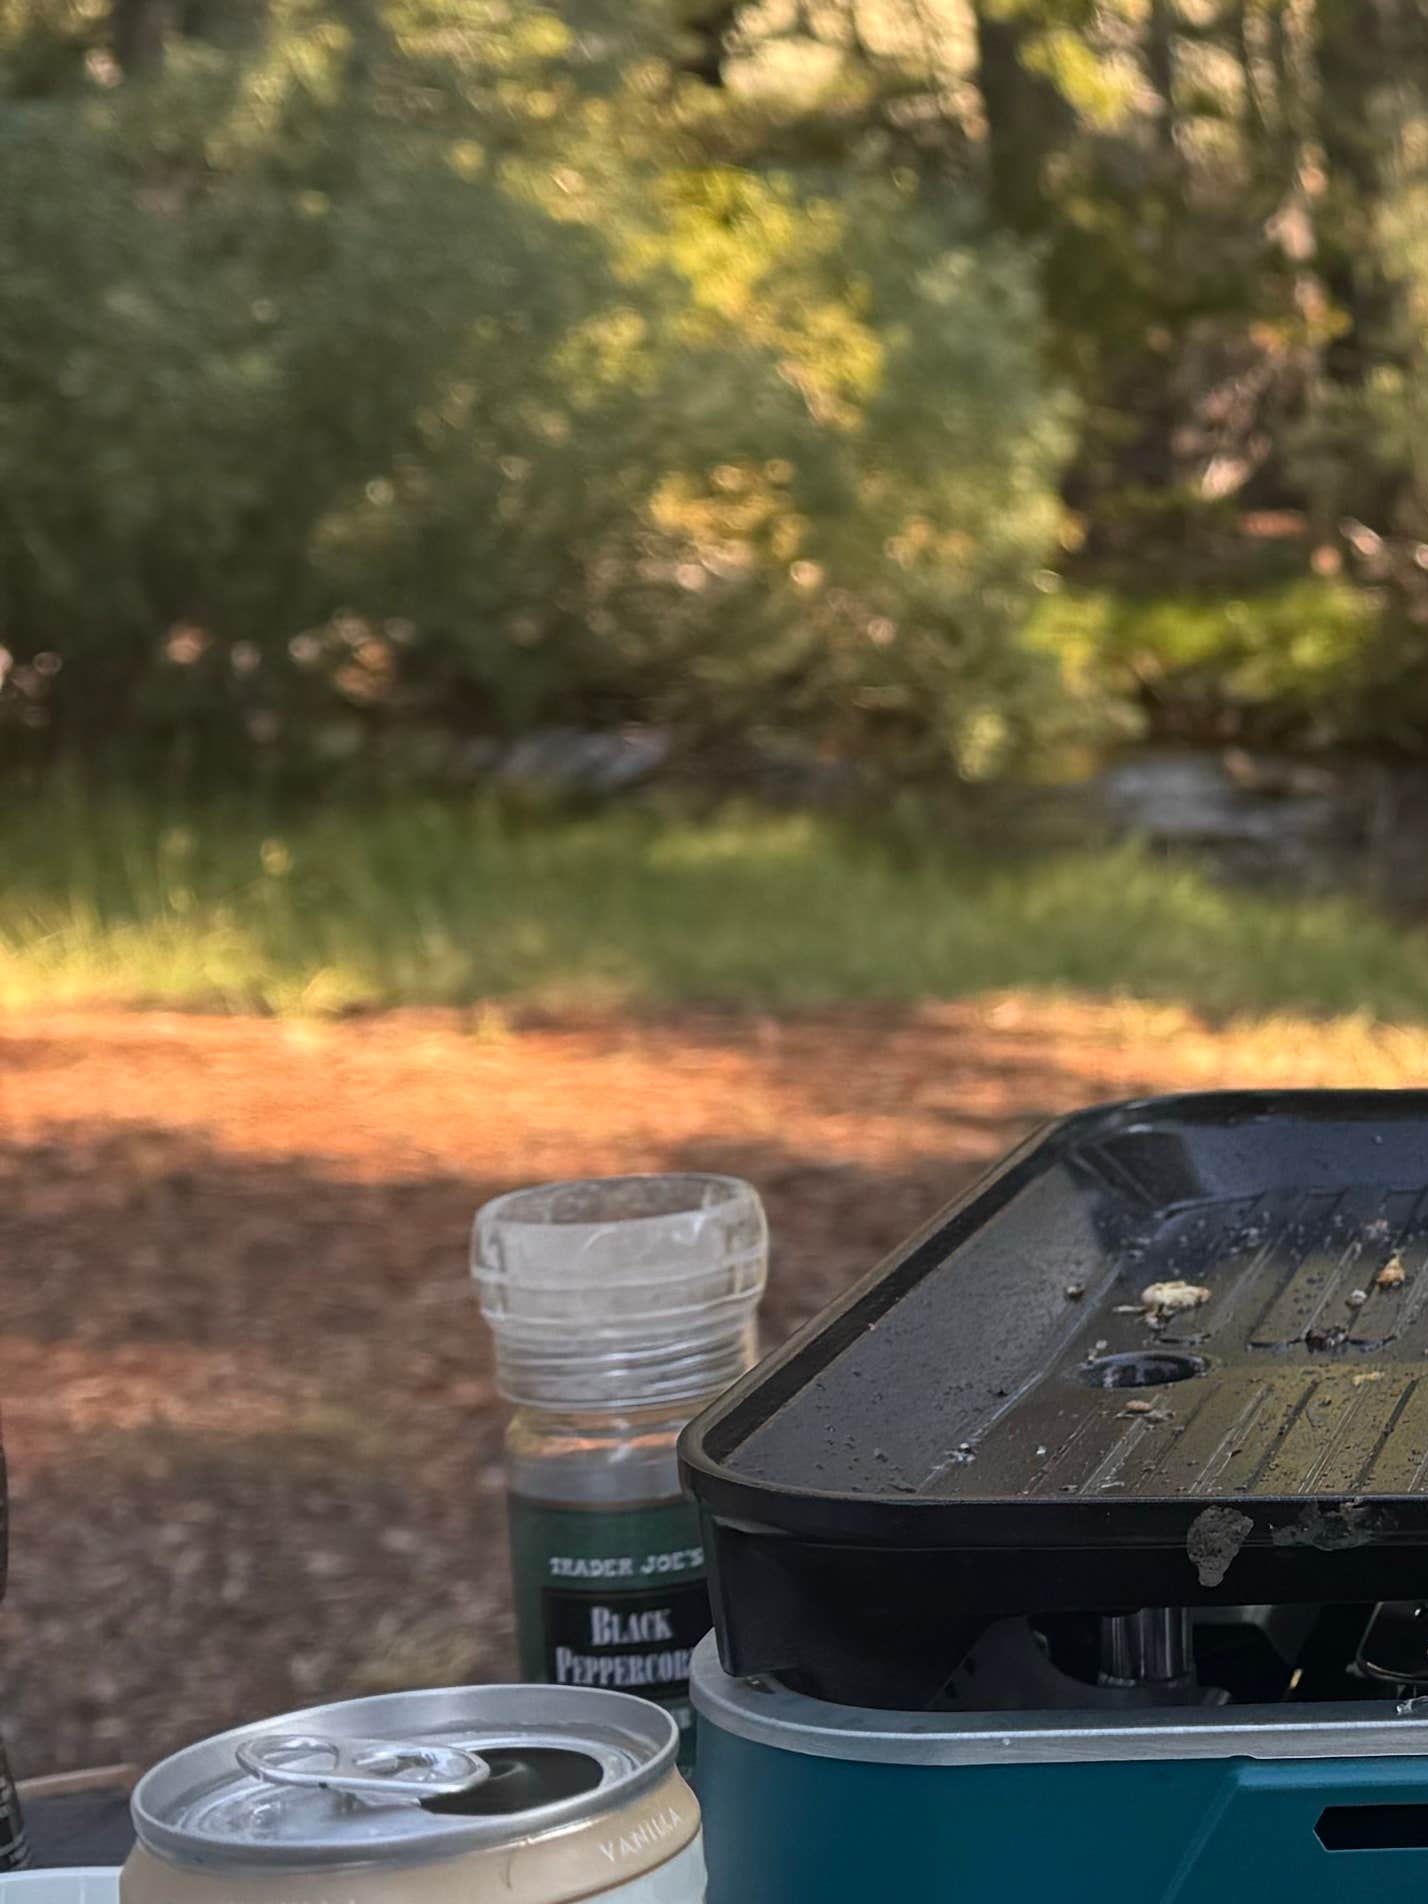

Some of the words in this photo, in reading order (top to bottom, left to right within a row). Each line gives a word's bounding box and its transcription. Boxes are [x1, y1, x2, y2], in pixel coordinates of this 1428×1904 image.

[549, 1556, 634, 1579] TRADER
[640, 1546, 704, 1575] JOE'S
[590, 1605, 674, 1647] BLACK
[555, 1646, 693, 1687] PEPPERCOR
[599, 1807, 684, 1862] VANILLA
